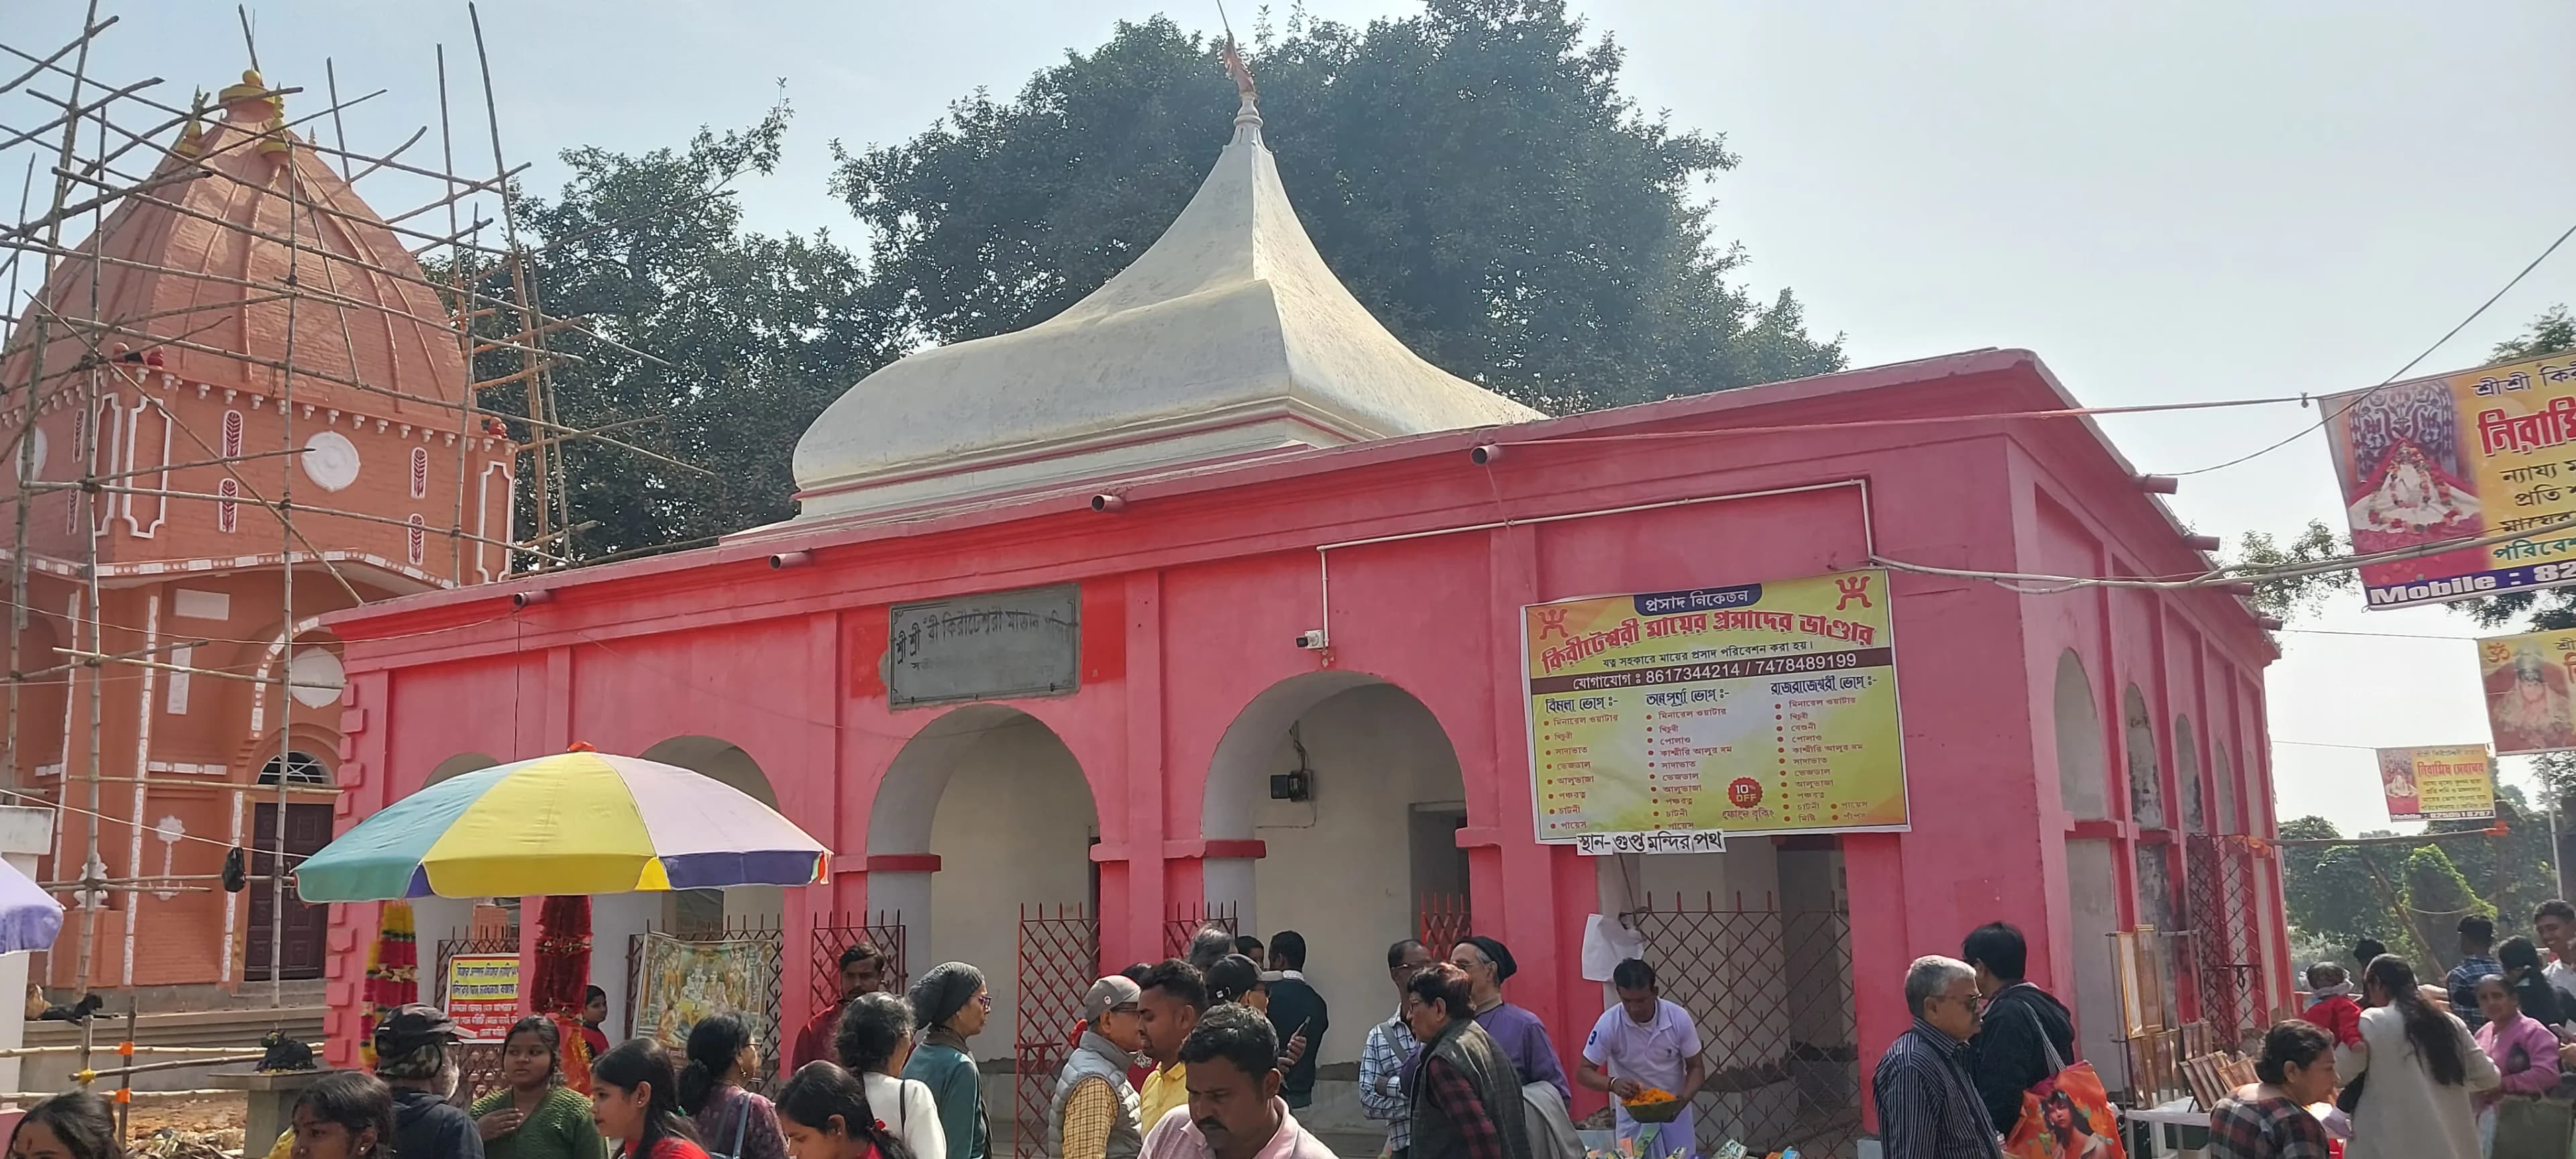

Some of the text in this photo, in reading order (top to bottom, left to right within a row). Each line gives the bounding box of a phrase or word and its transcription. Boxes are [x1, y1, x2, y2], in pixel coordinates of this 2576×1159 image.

[2515, 484, 2563, 506] প্রতি
[2369, 576, 2497, 604] Mobile
[1646, 590, 1749, 612] প্রসাদ নিকেতন
[1542, 618, 1640, 674] কিরীটেশ্বরী
[1644, 613, 1707, 637] মায়ের
[1713, 610, 1794, 632] প্রসাদের
[1619, 654, 1656, 666] সহকারে
[1660, 652, 1688, 663] মায়ের
[1692, 649, 1717, 660] প্রসাদ
[1721, 645, 1767, 657] পরিবেশন
[1770, 641, 1789, 653] করা
[1573, 671, 1631, 690] যোগাযোগ
[1646, 663, 1741, 683] 8617344214
[1756, 653, 1857, 675] 7478489199
[1839, 675, 1866, 689] ভোগ
[1691, 688, 1717, 702] ভোগ
[1788, 700, 1823, 708] মিনারেল
[1545, 697, 1576, 714] বিমলা
[1579, 696, 1606, 711] ভোগ
[1658, 707, 1727, 720] মিনারেল ওয়াটার
[1554, 714, 1619, 726] মিনারেল ওয়াটার
[1660, 736, 1691, 745] পোলাও
[1736, 793, 1757, 802] OFF
[1613, 832, 1646, 852] গুপ্ত
[1648, 830, 1691, 852] মন্দির
[1693, 830, 1723, 850] পথ
